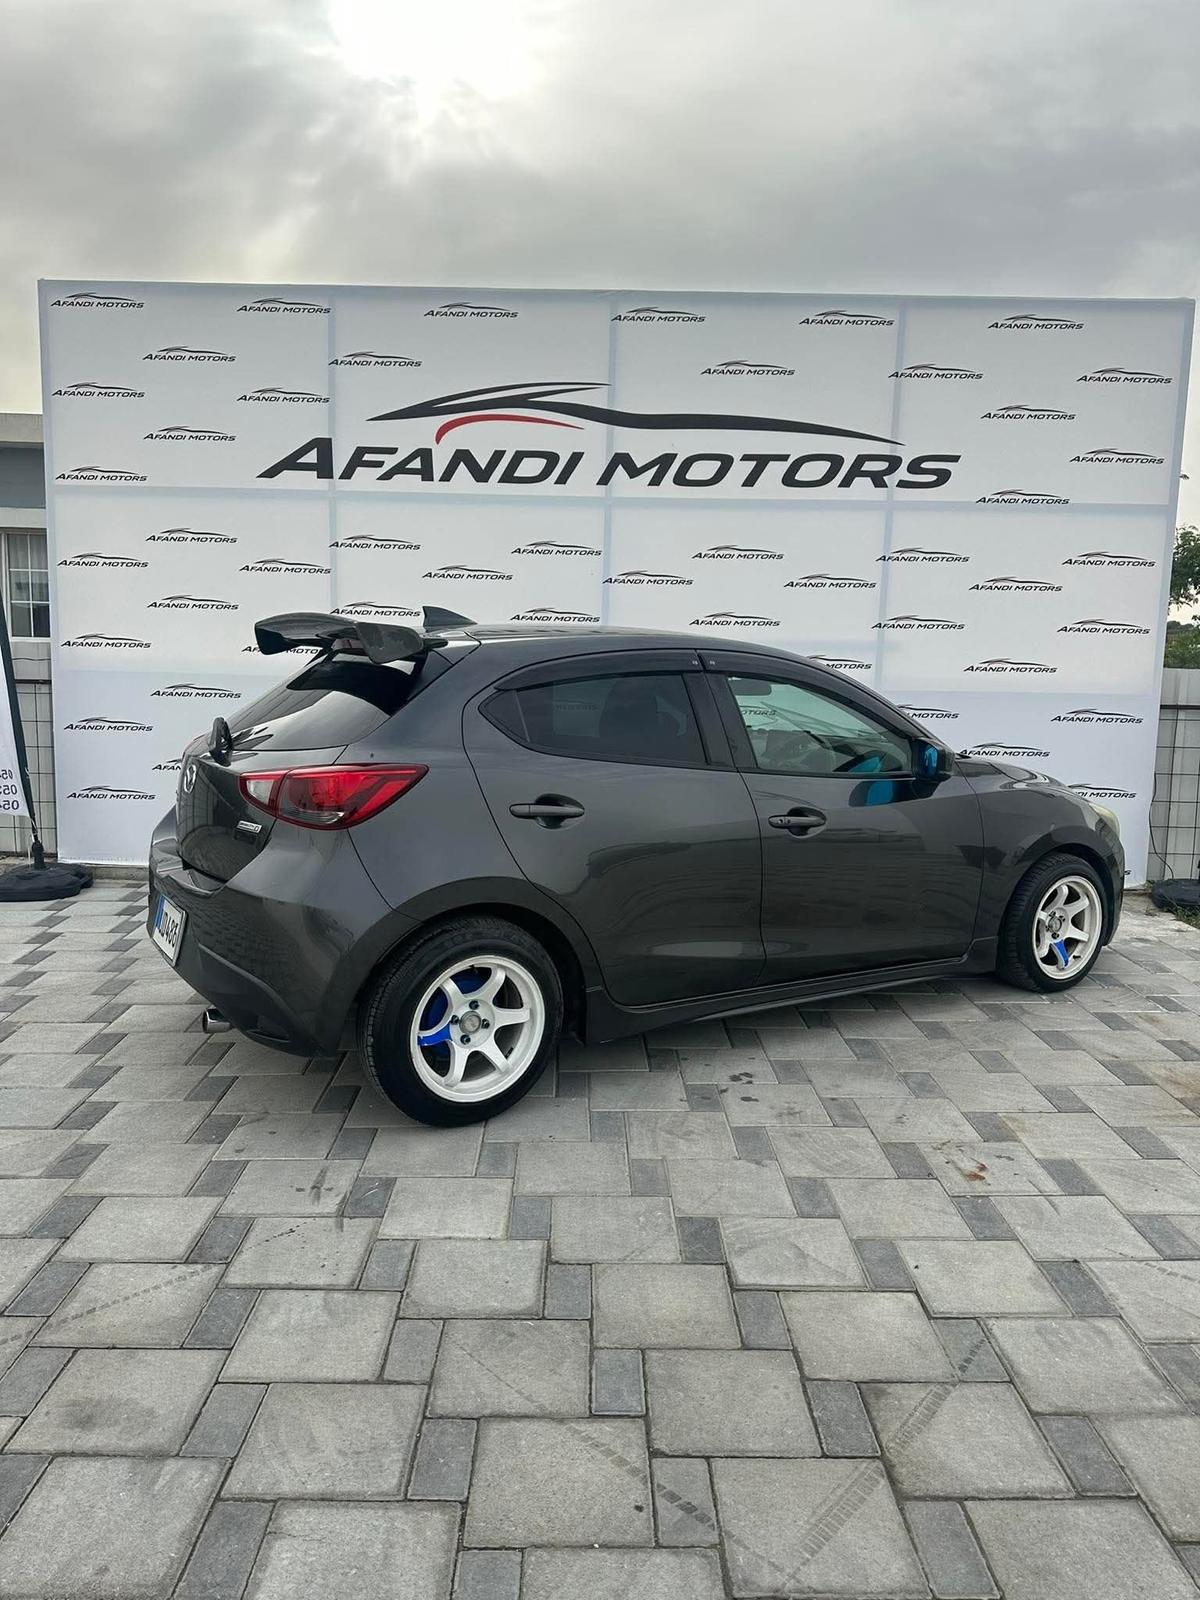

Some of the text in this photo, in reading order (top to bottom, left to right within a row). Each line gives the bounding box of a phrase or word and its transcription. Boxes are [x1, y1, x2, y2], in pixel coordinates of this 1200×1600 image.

[51, 299, 144, 309] AFANDI MOTORS
[237, 304, 331, 314] AFANDI MOTORS
[424, 309, 518, 319] AFANDI MOTORS
[611, 314, 706, 323] AFANDI MOTORS
[799, 317, 894, 327] AFANDI MOTORS
[988, 321, 1084, 330] AFANDI MOTORS
[143, 353, 236, 363] AFANDI MOTORS
[328, 358, 422, 368] AFANDI MOTORS
[701, 367, 795, 376] AFANDI MOTORS
[888, 370, 983, 380] AFANDI MOTORS
[1077, 374, 1172, 384] AFANDI MOTORS
[52, 389, 145, 398] AFANDI MOTORS
[237, 394, 330, 404] AFANDI MOTORS
[981, 412, 1076, 421] AFANDI MOTORS
[144, 432, 236, 442] AFANDI MOTORS
[256, 437, 961, 489] AFANDI MOTORS
[1069, 455, 1164, 465] AFANDI MOTORS
[55, 472, 148, 481] AFANDI MOTORS
[976, 496, 1070, 505] AFANDI MOTORS
[145, 535, 237, 543] AFANDI MOTORS
[329, 541, 421, 551] AFANDI MOTORS
[511, 547, 602, 557] AFANDI MOTORS
[692, 551, 784, 560] AFANDI MOTORS
[875, 554, 970, 563] AFANDI MOTORS
[1062, 557, 1156, 568] AFANDI MOTORS
[57, 559, 149, 568] AFANDI MOTORS
[239, 564, 332, 574] AFANDI MOTORS
[422, 571, 513, 580] AFANDI MOTORS
[602, 576, 694, 586] AFANDI MOTORS
[784, 580, 877, 588] AFANDI MOTORS
[969, 583, 1063, 592] AFANDI MOTORS
[147, 601, 239, 611] AFANDI MOTORS
[330, 607, 421, 617] AFANDI MOTORS
[510, 613, 600, 623] AFANDI MOTORS
[689, 618, 781, 626] AFANDI MOTORS
[871, 621, 965, 630] AFANDI MOTORS
[1057, 625, 1150, 635] AFANDI MOTORS
[61, 639, 151, 648] AFANDI MOTORS
[964, 664, 1057, 673] AFANDI MOTORS
[150, 689, 241, 698] AFANDI MOTORS
[1051, 714, 1143, 723] AFANDI MOTORS
[64, 723, 153, 732] AFANDI MOTORS
[960, 749, 1050, 758] AFANDI MOTORS
[65, 792, 156, 801] AFANDI MOTORS
[1089, 791, 1137, 799] MOTORS
